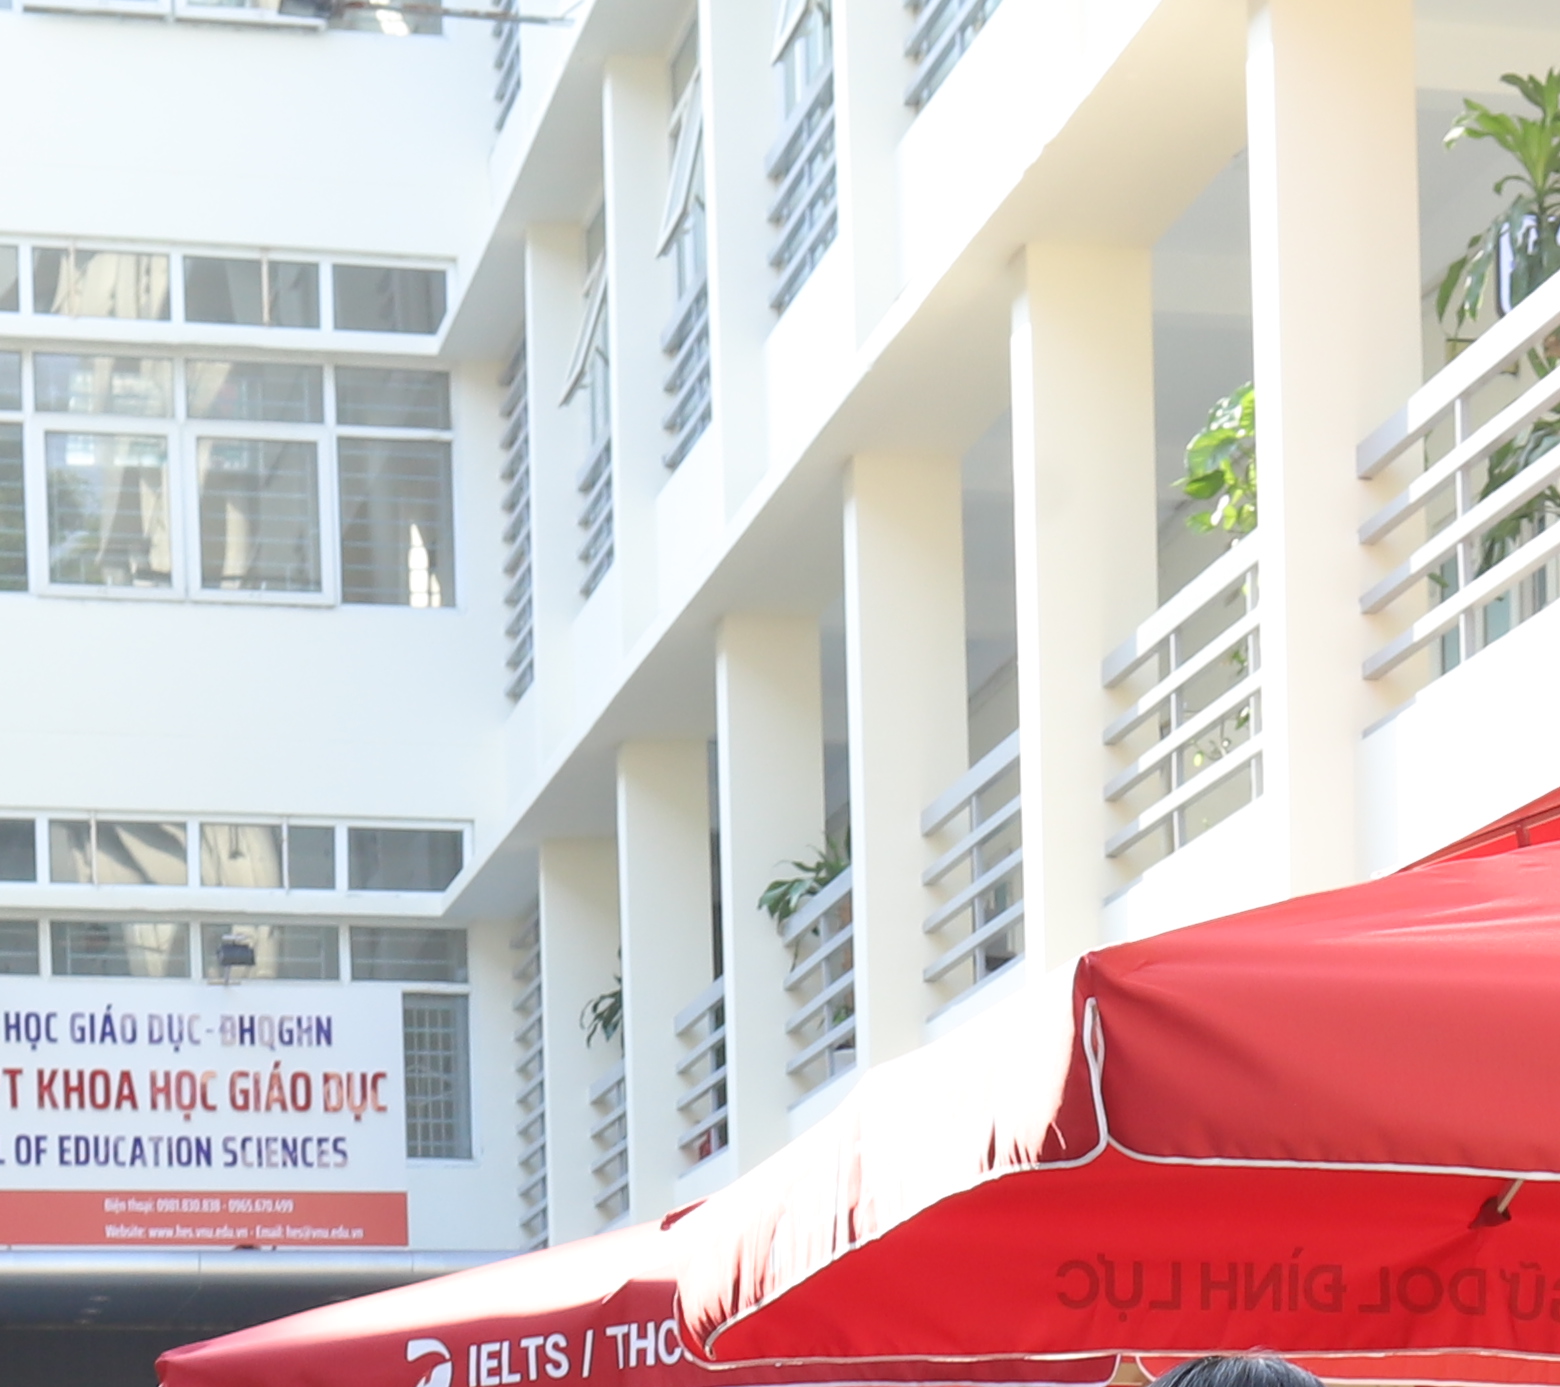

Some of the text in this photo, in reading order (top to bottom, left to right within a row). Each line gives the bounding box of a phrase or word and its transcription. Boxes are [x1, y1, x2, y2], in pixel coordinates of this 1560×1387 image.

[4, 1011, 58, 1051] HỌC
[69, 1003, 138, 1045] GIÁO
[37, 1068, 139, 1111] KHOA
[149, 1070, 219, 1122] HỌC
[228, 1060, 313, 1113] GIÁO
[323, 1072, 389, 1122] DỤC
[14, 1134, 48, 1167] OF
[58, 1135, 213, 1168] EDUCATION
[222, 1136, 349, 1169] SCIENCES
[468, 1333, 570, 1387] IELTS
[582, 1329, 593, 1378] /
